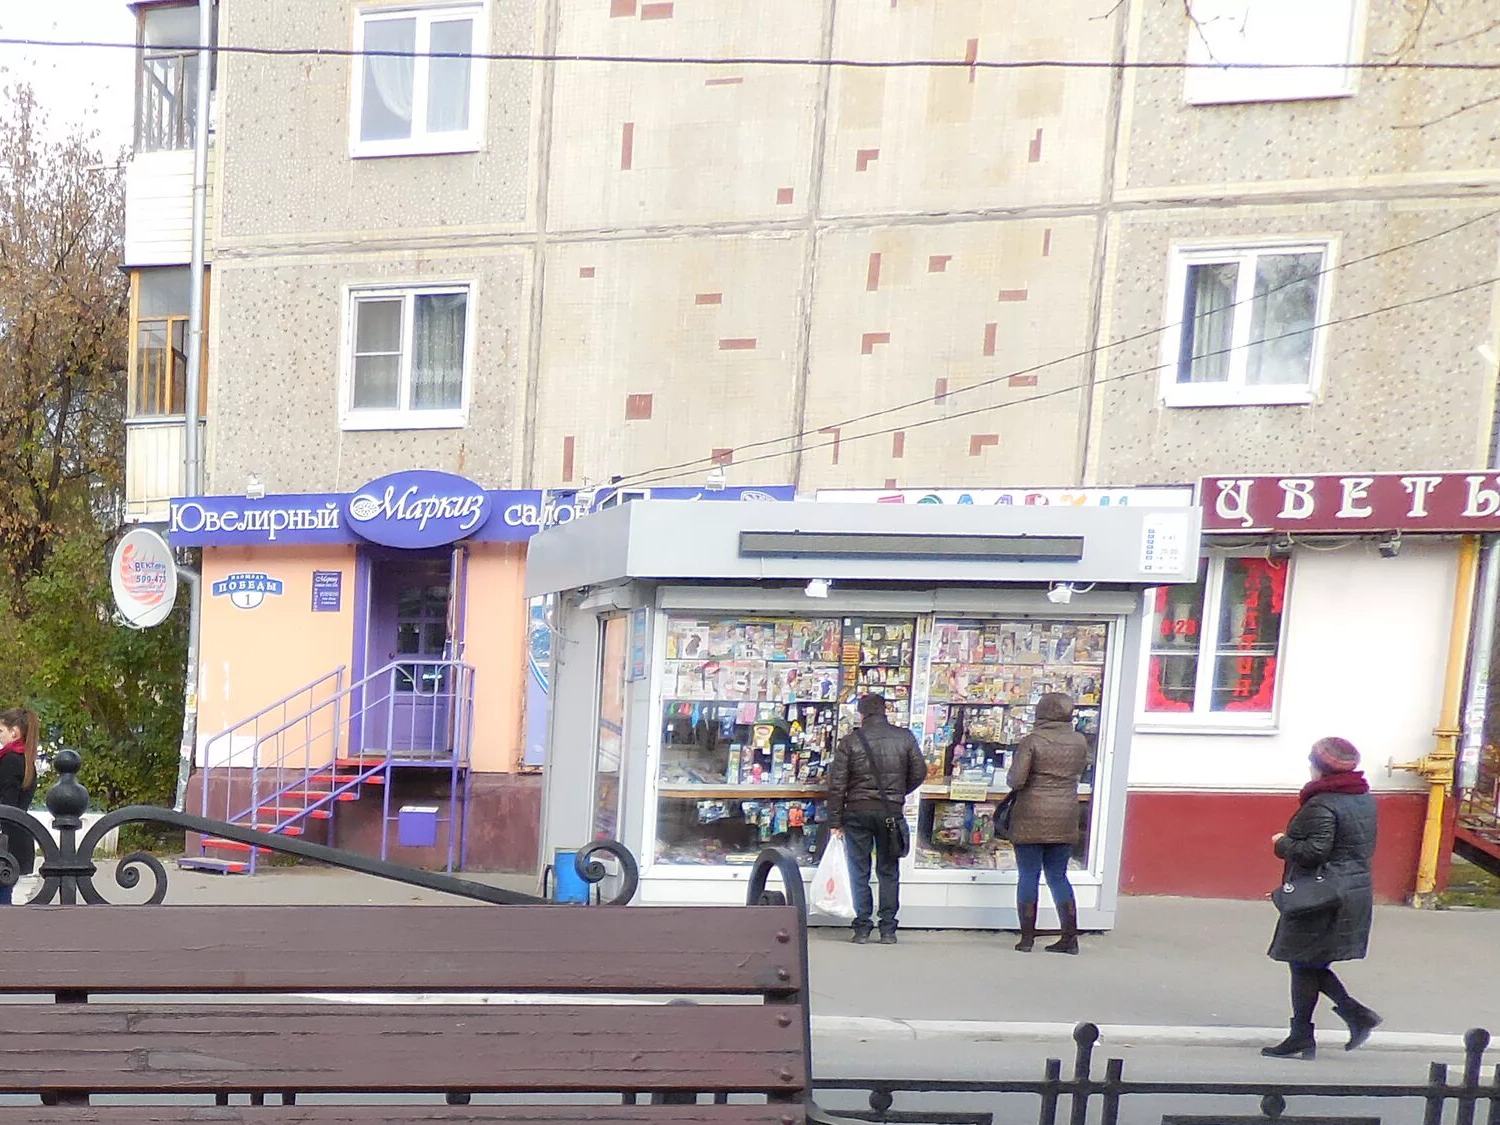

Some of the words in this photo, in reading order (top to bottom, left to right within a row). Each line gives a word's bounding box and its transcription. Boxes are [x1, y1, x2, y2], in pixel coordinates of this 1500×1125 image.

[169, 501, 340, 540] Ювелирный
[372, 485, 484, 531] Маркиз
[218, 580, 277, 592] ПОБЕДЫ
[245, 594, 251, 606] 1
